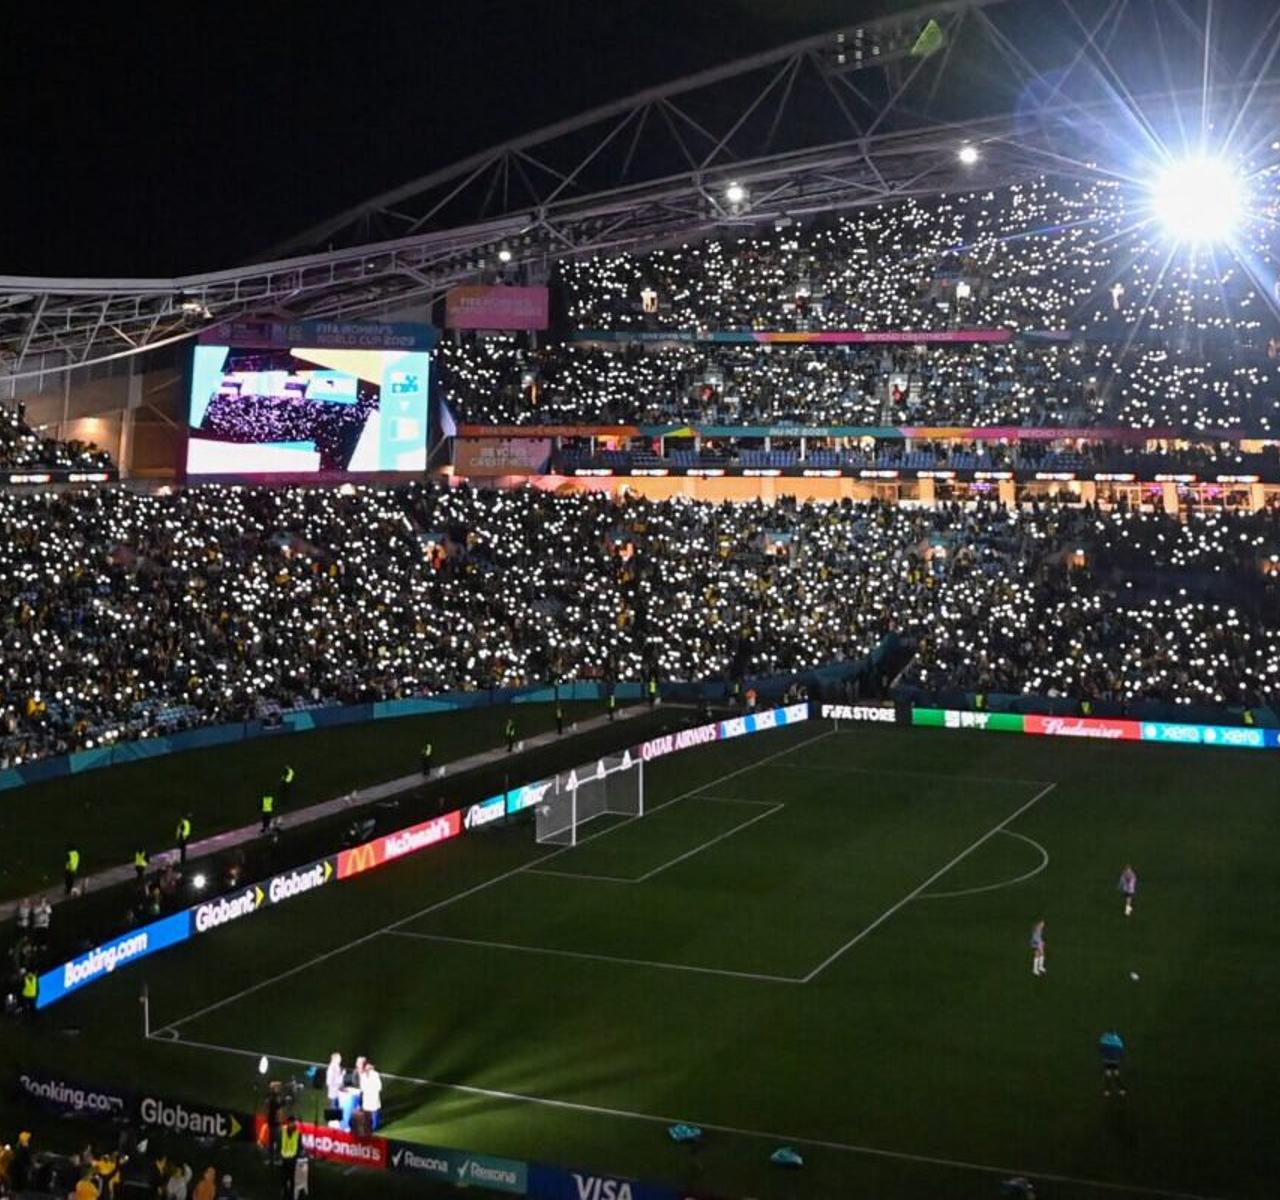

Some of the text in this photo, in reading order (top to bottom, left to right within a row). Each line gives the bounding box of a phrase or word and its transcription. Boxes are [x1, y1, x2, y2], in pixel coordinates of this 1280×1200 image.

[1041, 717, 1123, 738] Budweiser
[269, 864, 324, 903] Globant
[196, 889, 254, 932] Globant
[64, 932, 148, 988] Booking.com
[141, 1098, 227, 1136] Globant
[301, 1133, 381, 1161] McDonald's
[404, 1150, 448, 1173] Rexona
[572, 1174, 633, 1200] VISA
